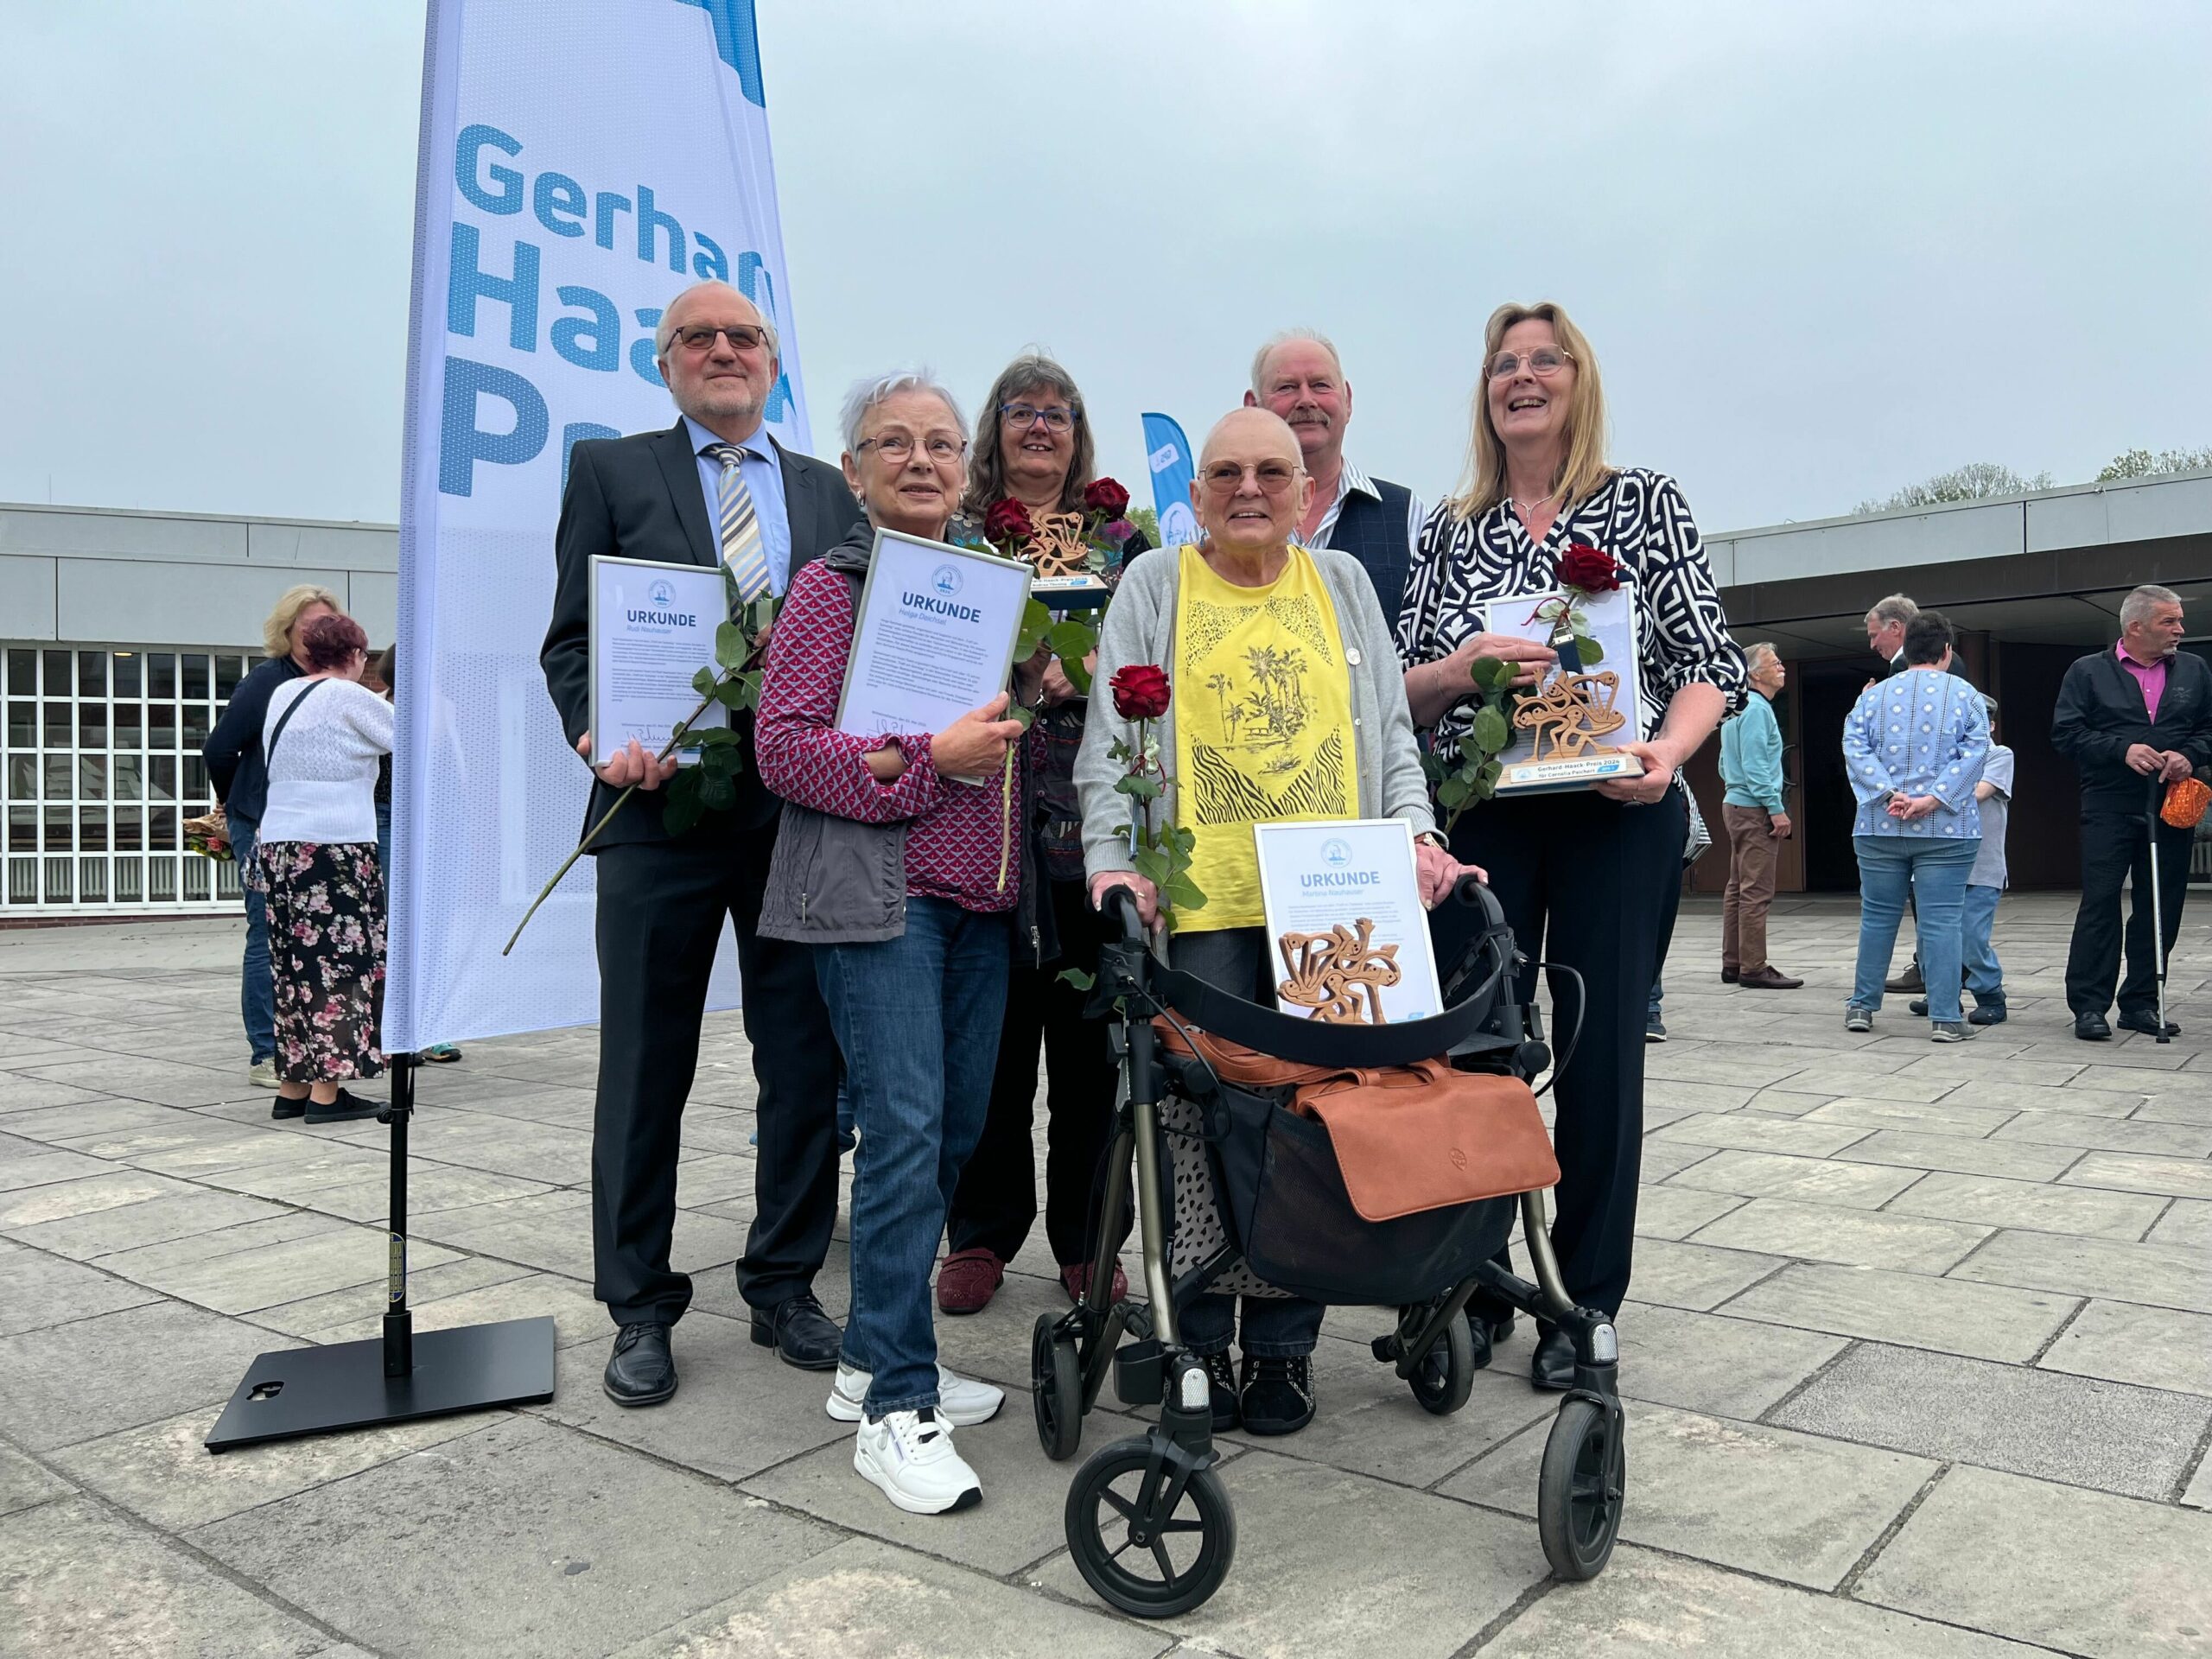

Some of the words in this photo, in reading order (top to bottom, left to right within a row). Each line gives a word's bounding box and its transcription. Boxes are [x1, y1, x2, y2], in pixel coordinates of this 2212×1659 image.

[455, 124, 776, 318] Gerhar
[626, 609, 696, 627] URKUNDE
[902, 591, 982, 623] URKUNDE
[1300, 871, 1381, 887] URKUNDE
